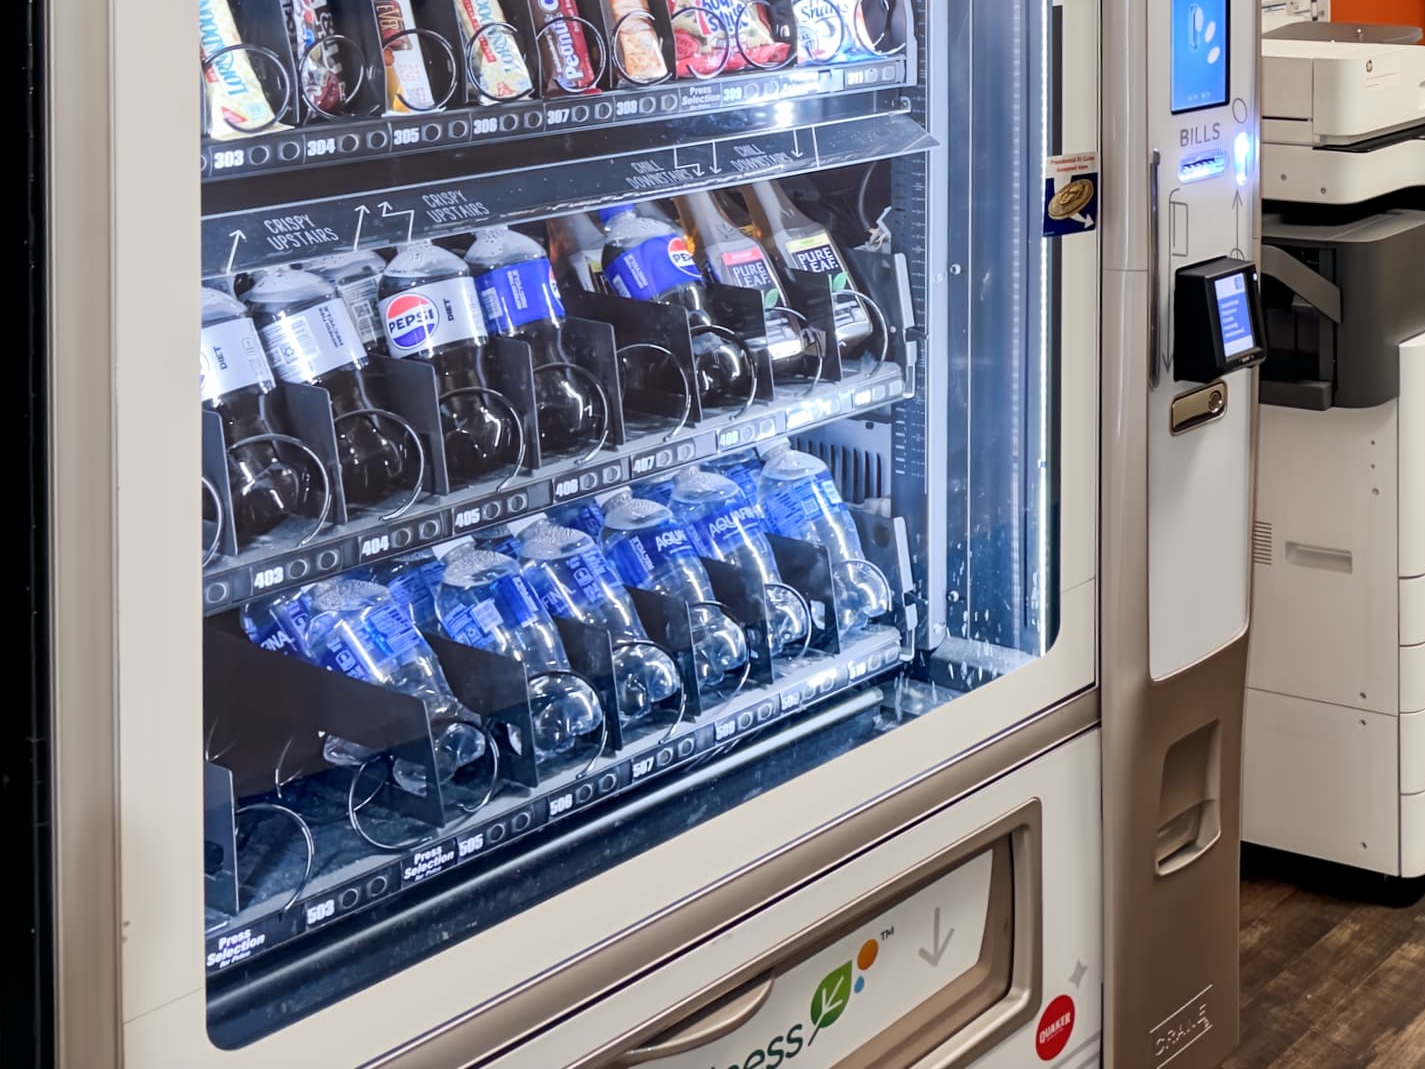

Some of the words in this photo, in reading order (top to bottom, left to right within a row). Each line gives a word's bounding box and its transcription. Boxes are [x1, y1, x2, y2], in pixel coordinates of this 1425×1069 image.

[682, 93, 721, 105] Selection
[547, 109, 569, 125] 307
[393, 127, 420, 144] 305
[1180, 123, 1221, 147] BILLS
[307, 139, 337, 157] 304
[733, 144, 763, 158] CHILL
[213, 151, 245, 169] 303
[630, 159, 660, 174] CHILL
[730, 151, 791, 172] DOWNSTAIRS
[625, 169, 692, 190] DOWNSTAIRS
[422, 189, 468, 209] CRISPY
[426, 201, 491, 224] UPSTAIRS
[263, 214, 316, 235] CRISPY
[267, 226, 340, 252] UPSTAIRS
[797, 247, 833, 263] PURE
[733, 262, 766, 277] PURE
[388, 308, 435, 334] PEPSI
[213, 345, 229, 371] DIET
[633, 455, 655, 473] 407
[455, 508, 480, 528] 405
[361, 536, 389, 556] 404
[254, 567, 284, 589] 403
[632, 760, 654, 778] 507
[414, 845, 443, 865] Press
[458, 834, 483, 857] 505
[403, 851, 454, 880] Selection
[306, 900, 335, 925] 503
[218, 929, 252, 951] Press
[206, 934, 266, 967] Selection
[1039, 1011, 1072, 1045] QUAKER
